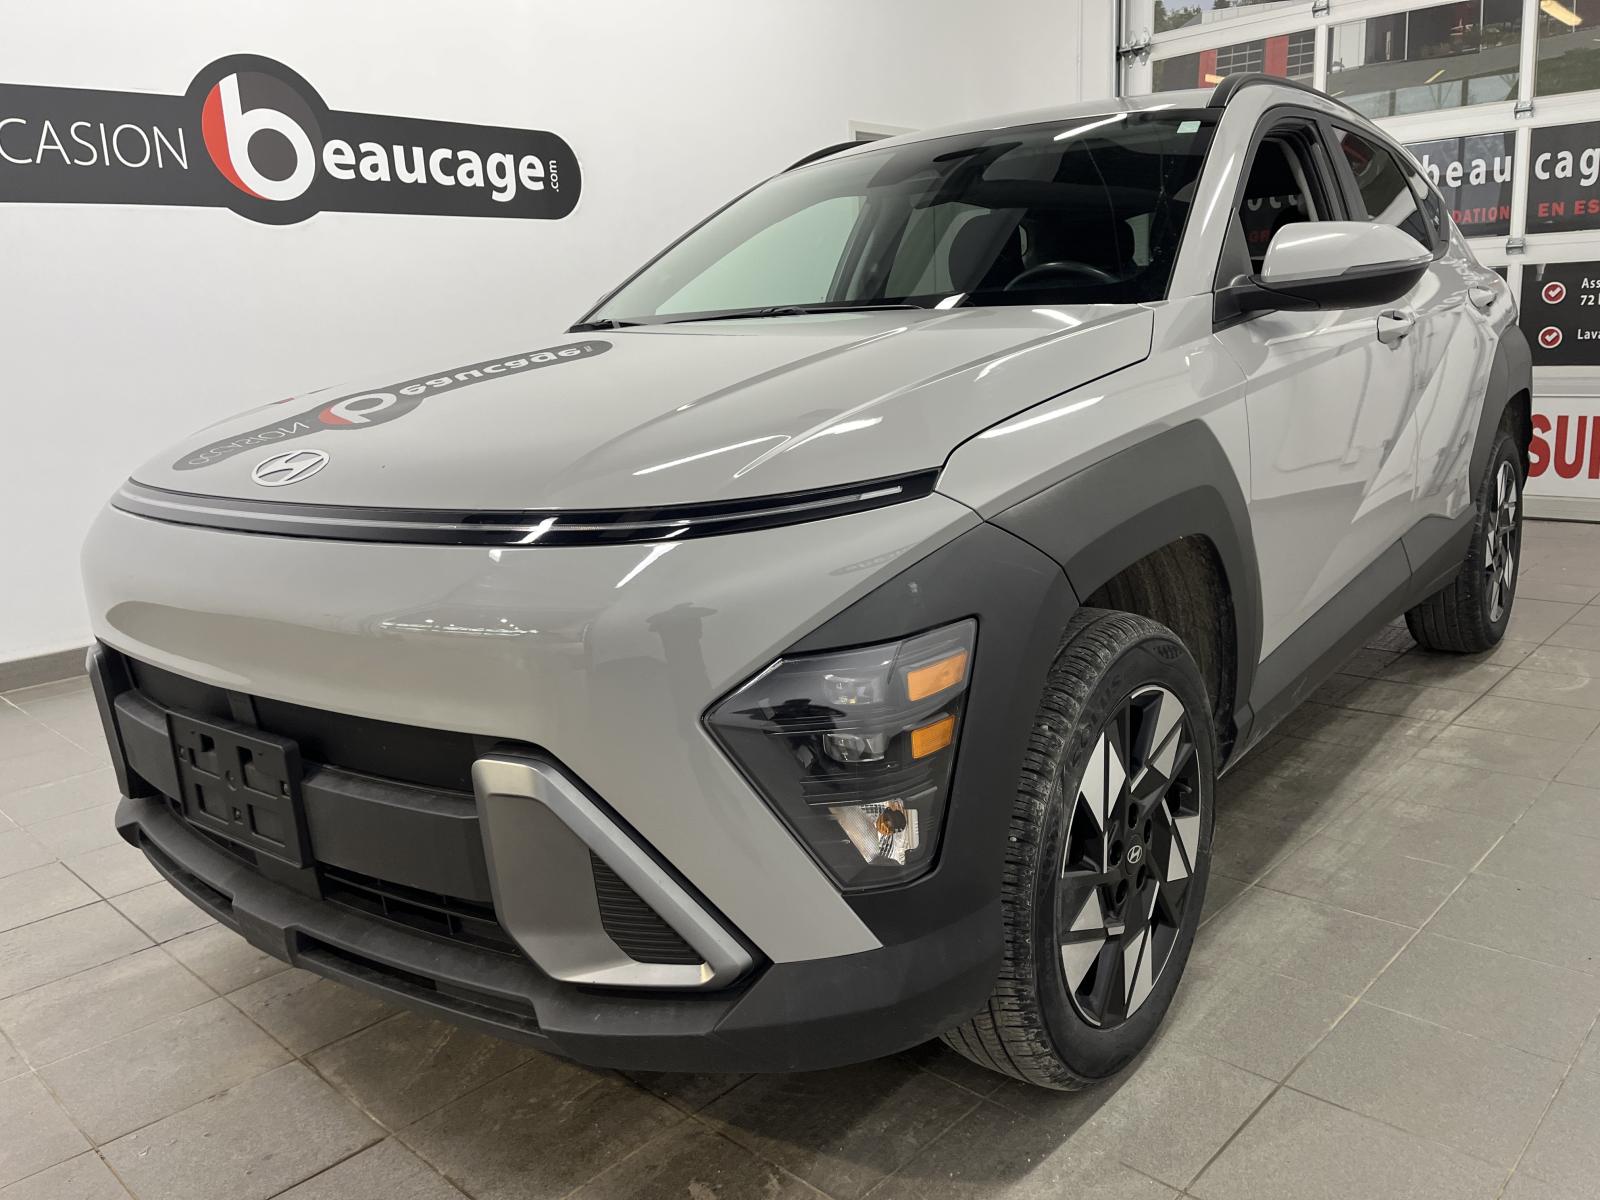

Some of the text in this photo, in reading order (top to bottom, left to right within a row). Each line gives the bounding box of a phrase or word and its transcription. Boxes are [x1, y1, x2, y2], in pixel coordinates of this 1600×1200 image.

[219, 73, 545, 202] beaucage
[1538, 202, 1565, 218] EN
[1580, 295, 1595, 305] 72
